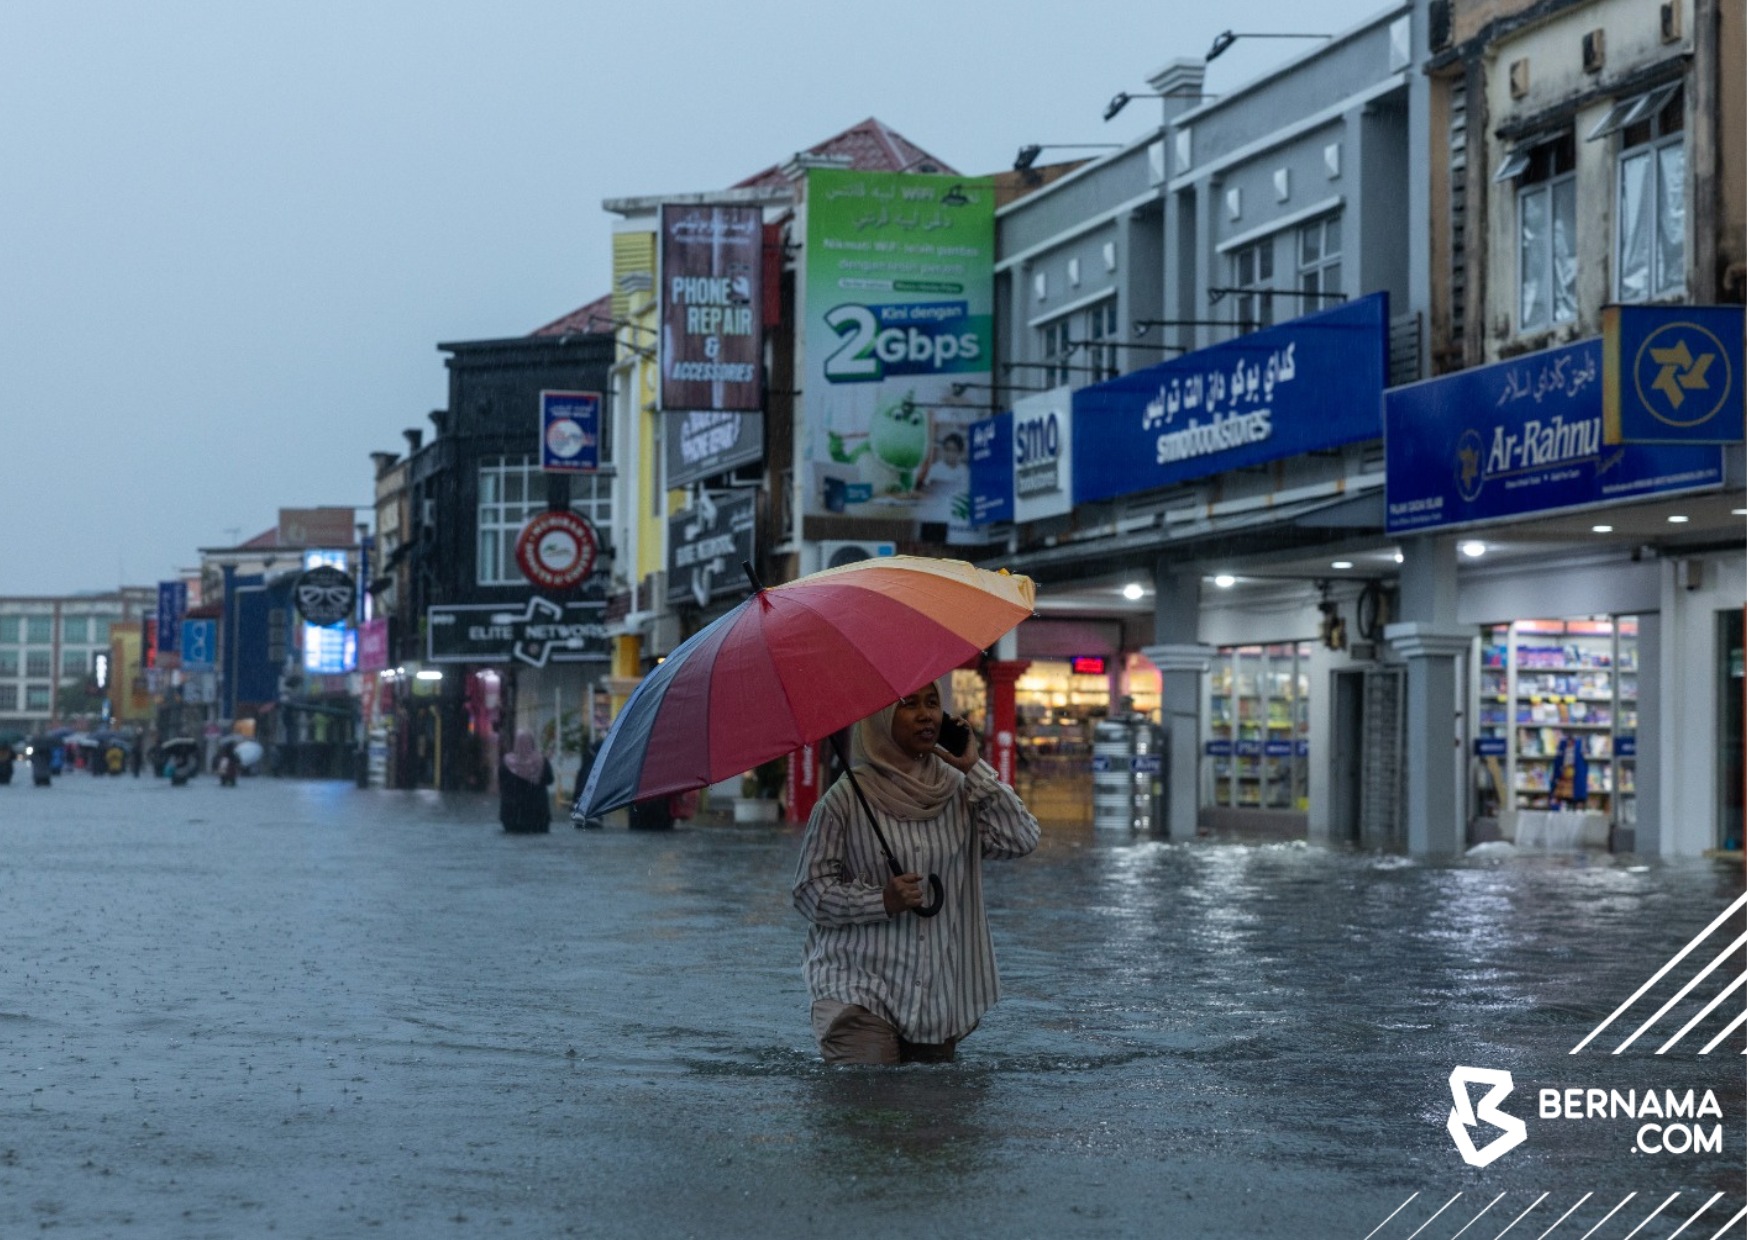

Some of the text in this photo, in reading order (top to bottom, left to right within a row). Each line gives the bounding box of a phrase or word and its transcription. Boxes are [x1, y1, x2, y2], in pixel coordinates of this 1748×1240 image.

[671, 276, 732, 305] PHONE
[687, 306, 754, 336] REPAIR
[881, 305, 963, 321] Kini dengan
[704, 337, 720, 359] &
[824, 302, 980, 378] 2 Gbps
[671, 361, 755, 383] ACCESSORIES
[1016, 412, 1059, 464] smo
[1156, 408, 1273, 465] smobookstores
[1487, 415, 1602, 473] Ar-Rahnu
[468, 625, 514, 641] ELITE
